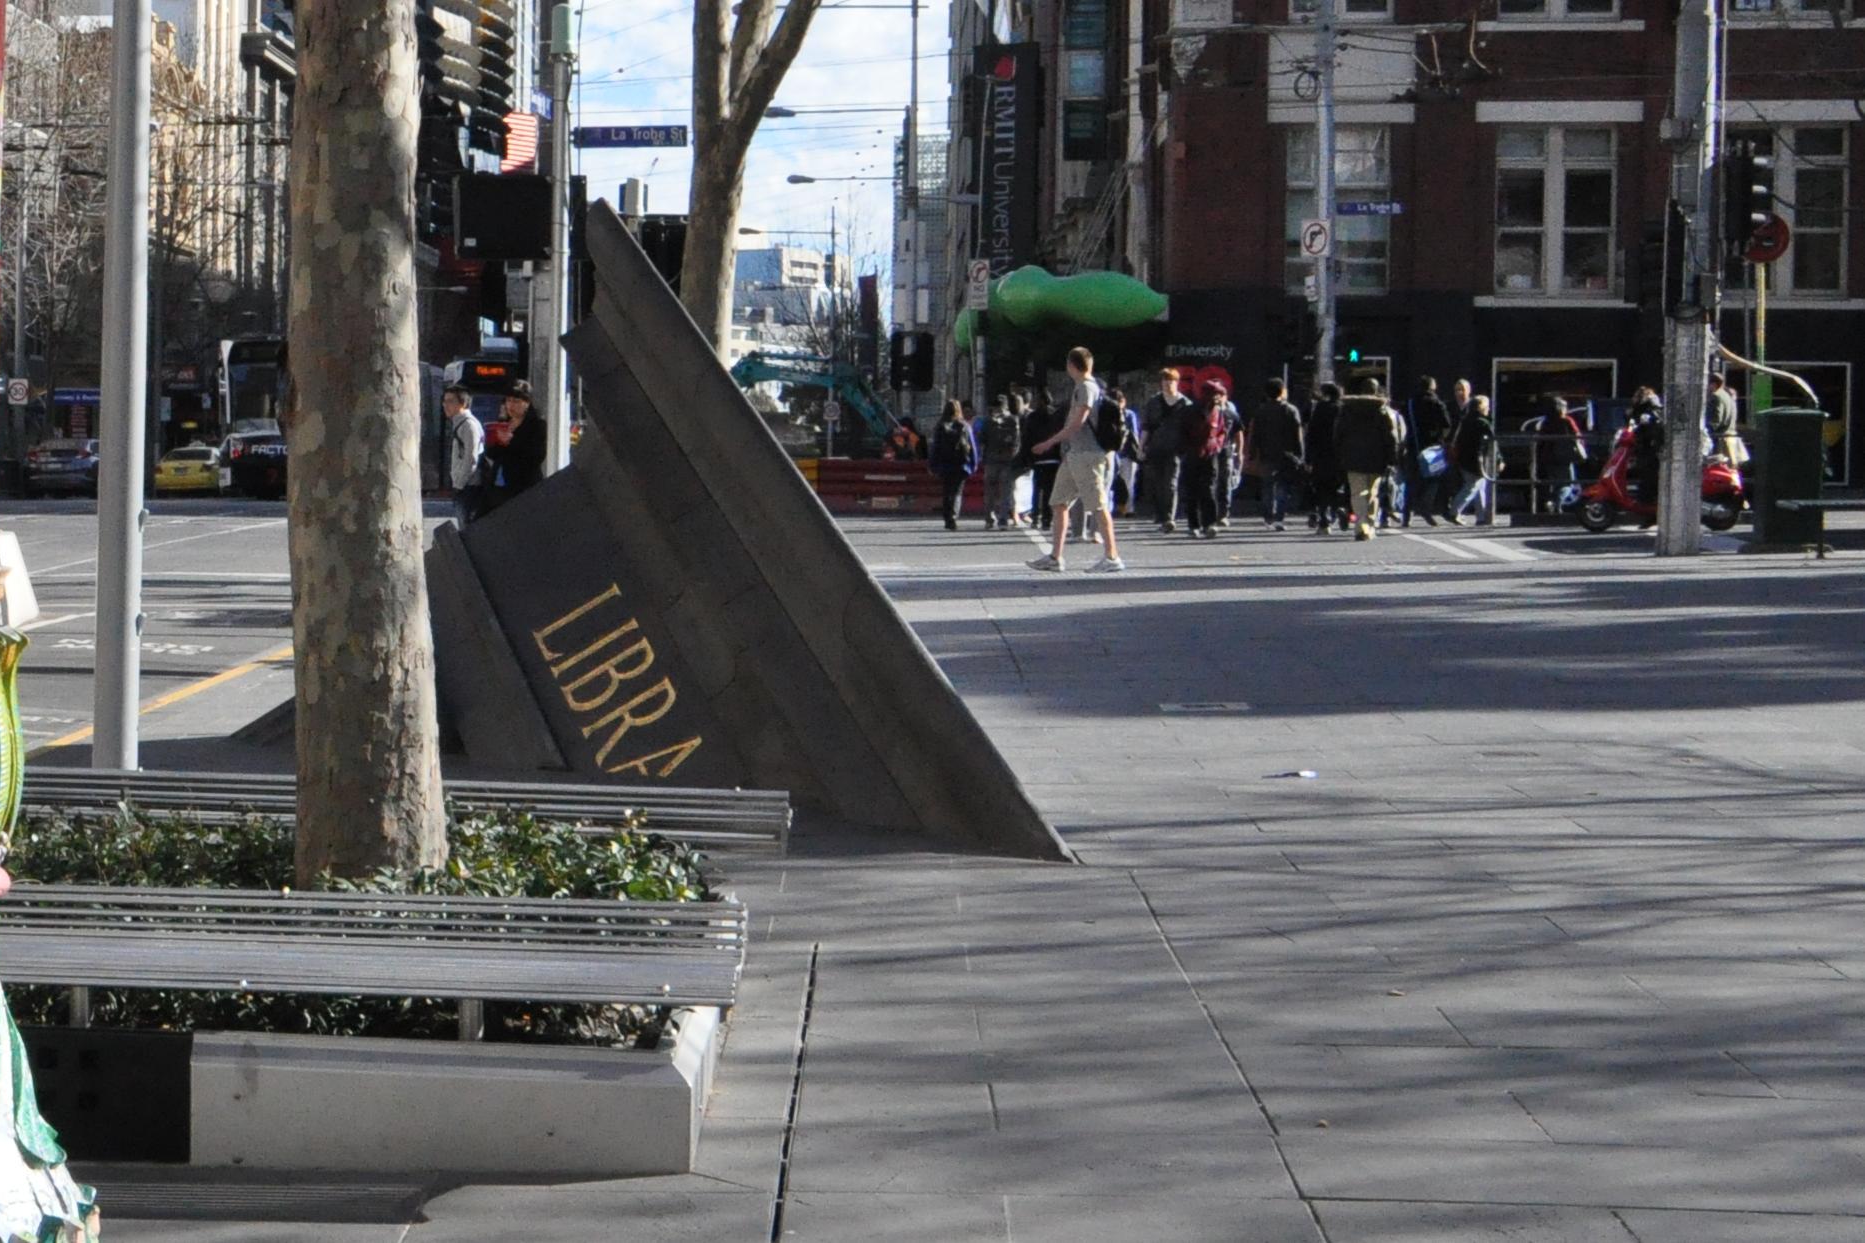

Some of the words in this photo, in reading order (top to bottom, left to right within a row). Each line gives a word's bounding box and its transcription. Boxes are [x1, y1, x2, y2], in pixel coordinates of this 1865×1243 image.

[994, 86, 1016, 159] RMIT
[611, 128, 627, 140] La
[633, 127, 665, 140] Trobe
[1175, 344, 1233, 361] University
[13, 386, 27, 397] 30
